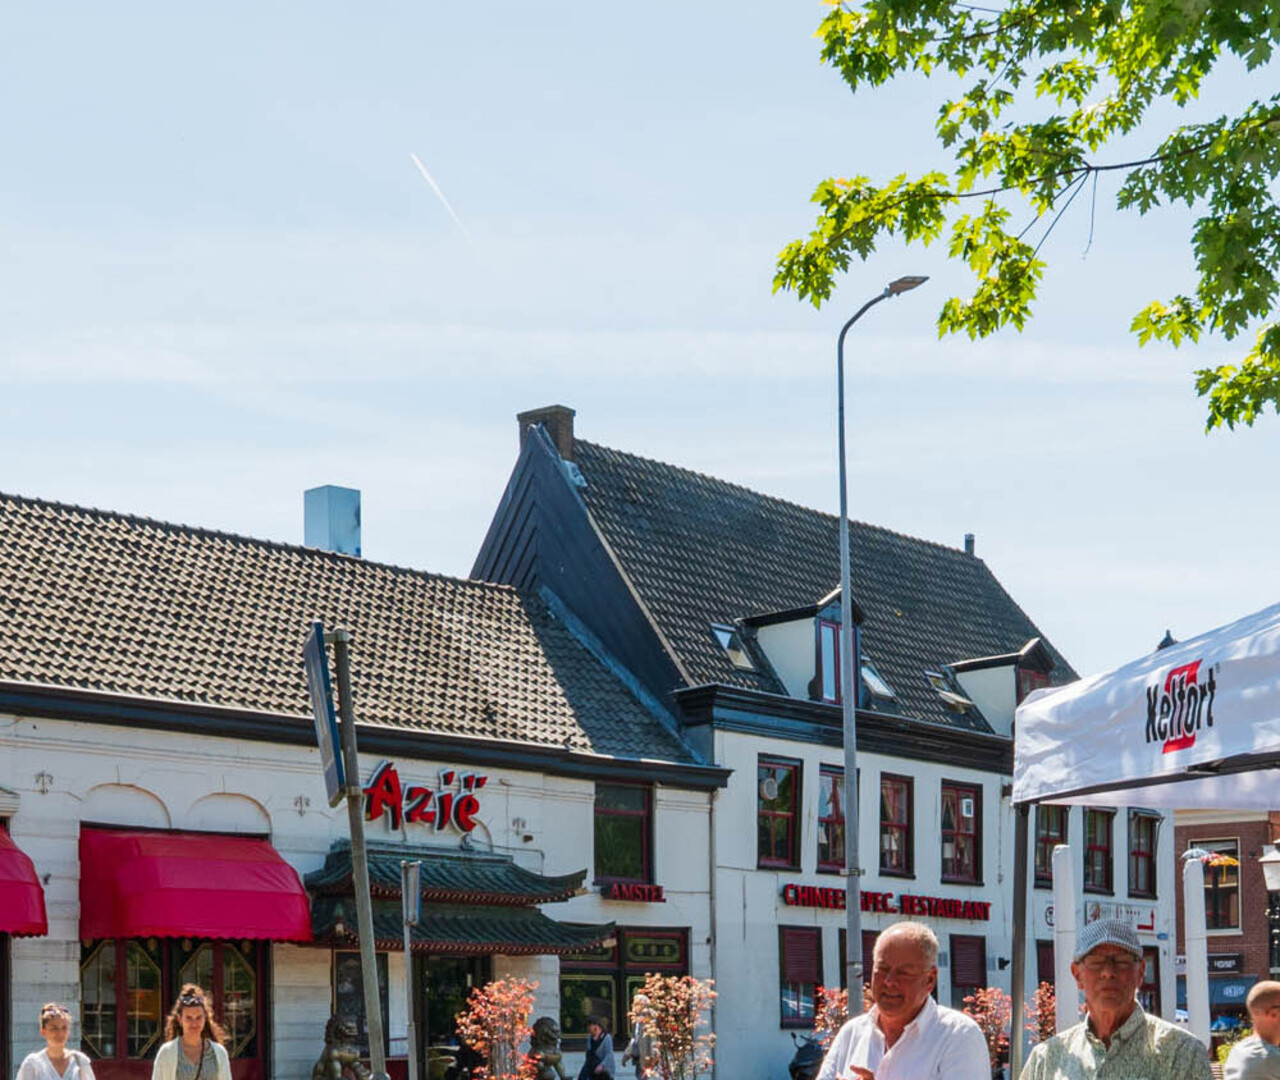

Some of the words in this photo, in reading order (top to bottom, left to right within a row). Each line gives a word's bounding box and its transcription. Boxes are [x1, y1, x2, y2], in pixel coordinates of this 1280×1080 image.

[361, 760, 488, 833] Azië
[610, 882, 667, 902] AMSTEL
[784, 884, 847, 910] CHINEE
[900, 894, 992, 921] RESTAURANT
